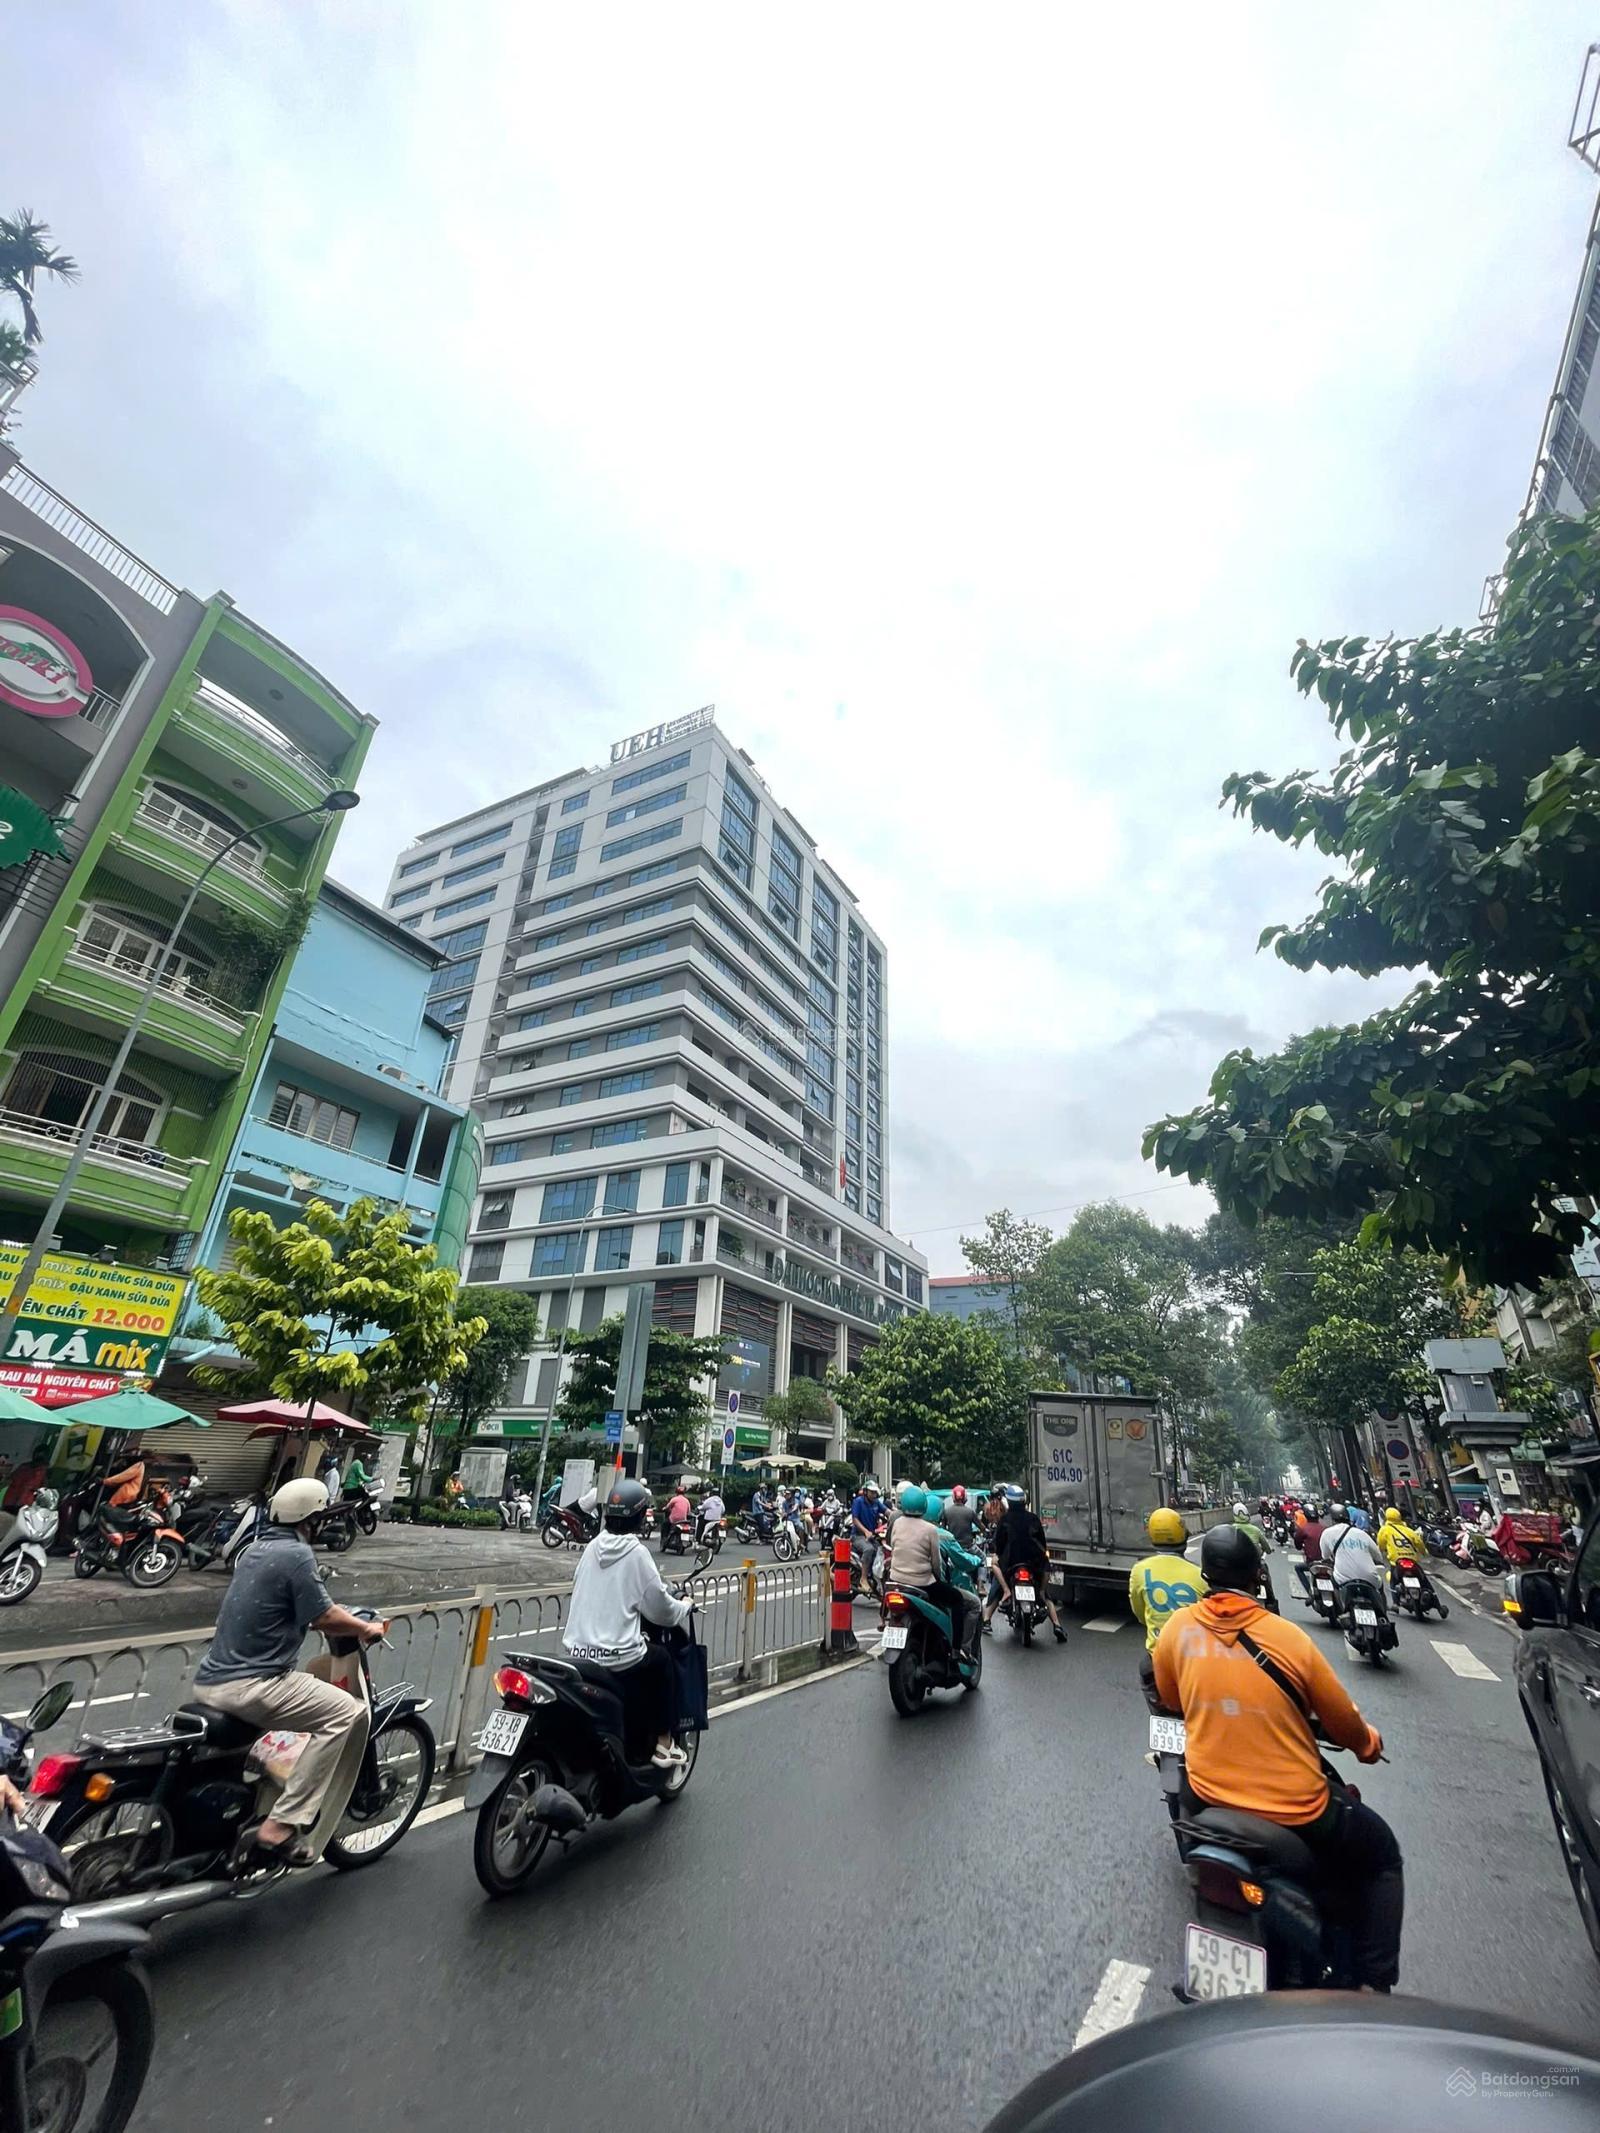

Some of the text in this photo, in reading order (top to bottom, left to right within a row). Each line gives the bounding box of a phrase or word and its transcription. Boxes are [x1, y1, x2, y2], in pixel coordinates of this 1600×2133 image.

[610, 723, 666, 763] UEH
[43, 1260, 74, 1274] mix
[99, 1270, 131, 1285] RIÊNG
[36, 1276, 67, 1291] mix
[69, 1280, 95, 1296] ĐẬU
[95, 1286, 126, 1300] XANH
[46, 1301, 87, 1320] CHẤT
[92, 1308, 166, 1331] 12.000
[6, 1329, 152, 1370] MÁ mix
[23, 1371, 42, 1385] MÁ
[44, 1373, 88, 1388] NGUYÊN
[88, 1377, 117, 1391] CHẤT
[1045, 1416, 1076, 1426] THE ONE
[1052, 1448, 1073, 1464] 61C
[1047, 1466, 1083, 1483] 504.90
[1144, 1569, 1198, 1613] be
[1198, 1934, 1251, 1979] 59-C1
